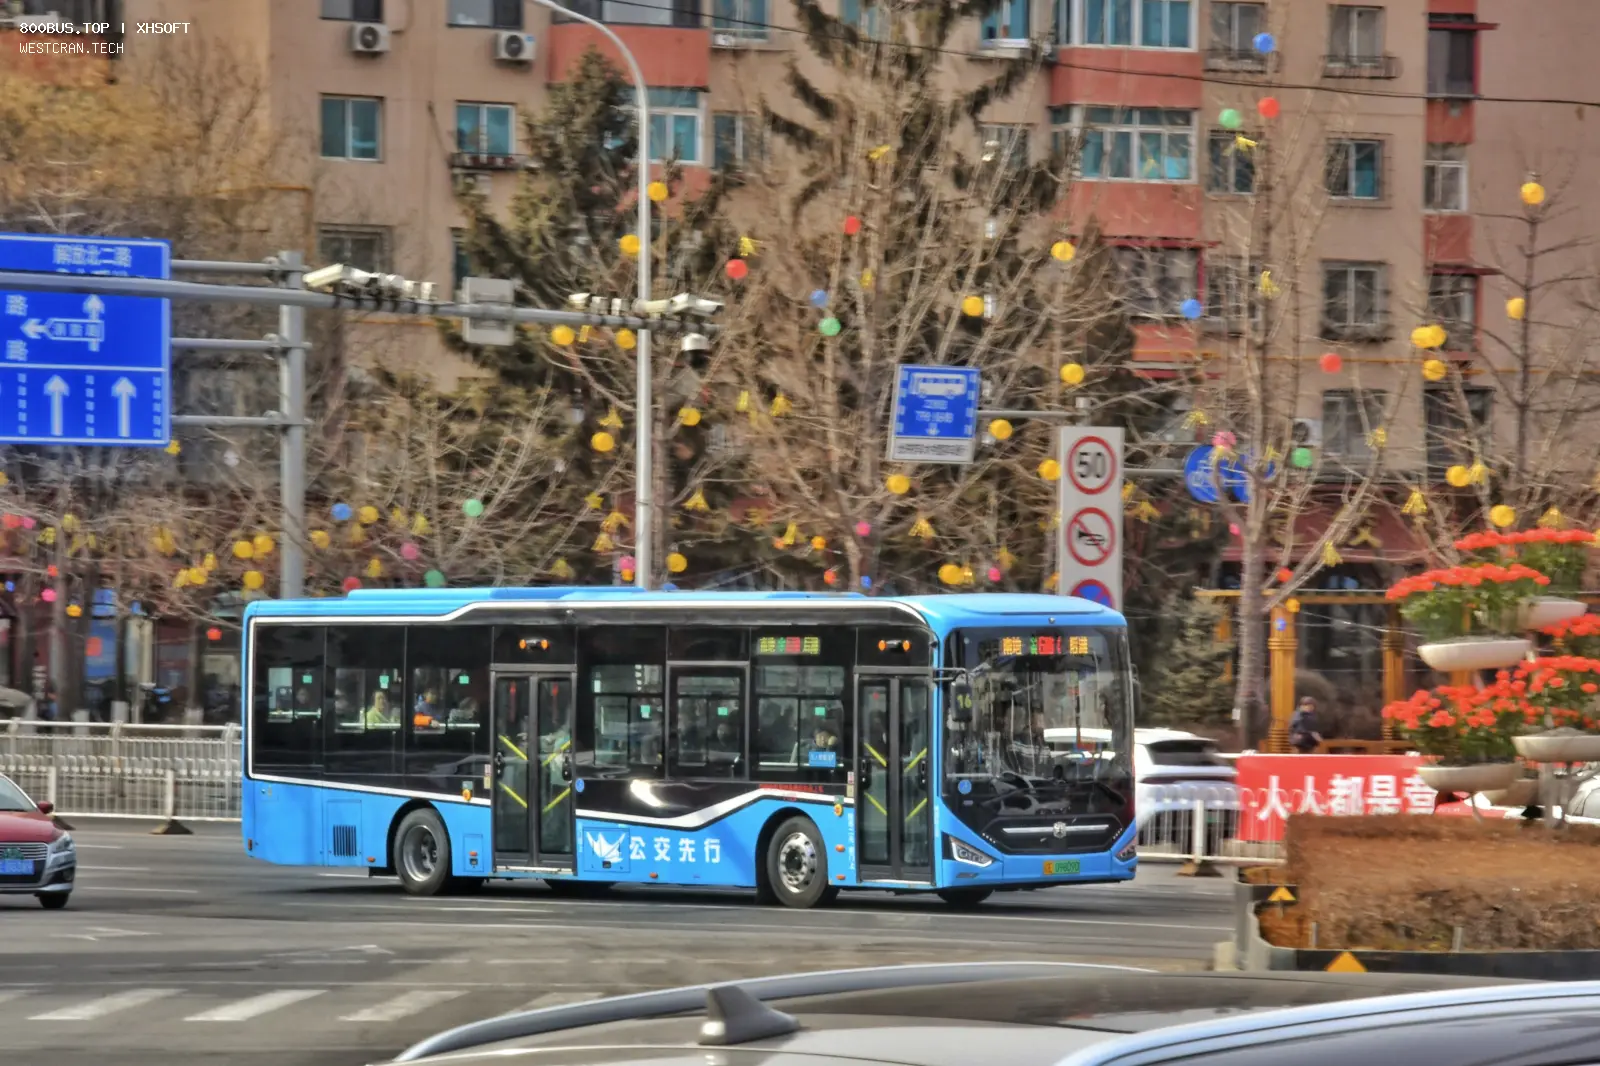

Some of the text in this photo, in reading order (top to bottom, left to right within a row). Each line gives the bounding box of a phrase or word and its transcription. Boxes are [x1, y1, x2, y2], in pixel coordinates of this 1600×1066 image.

[1077, 451, 1106, 479] 50
[629, 836, 721, 863] 公交先行
